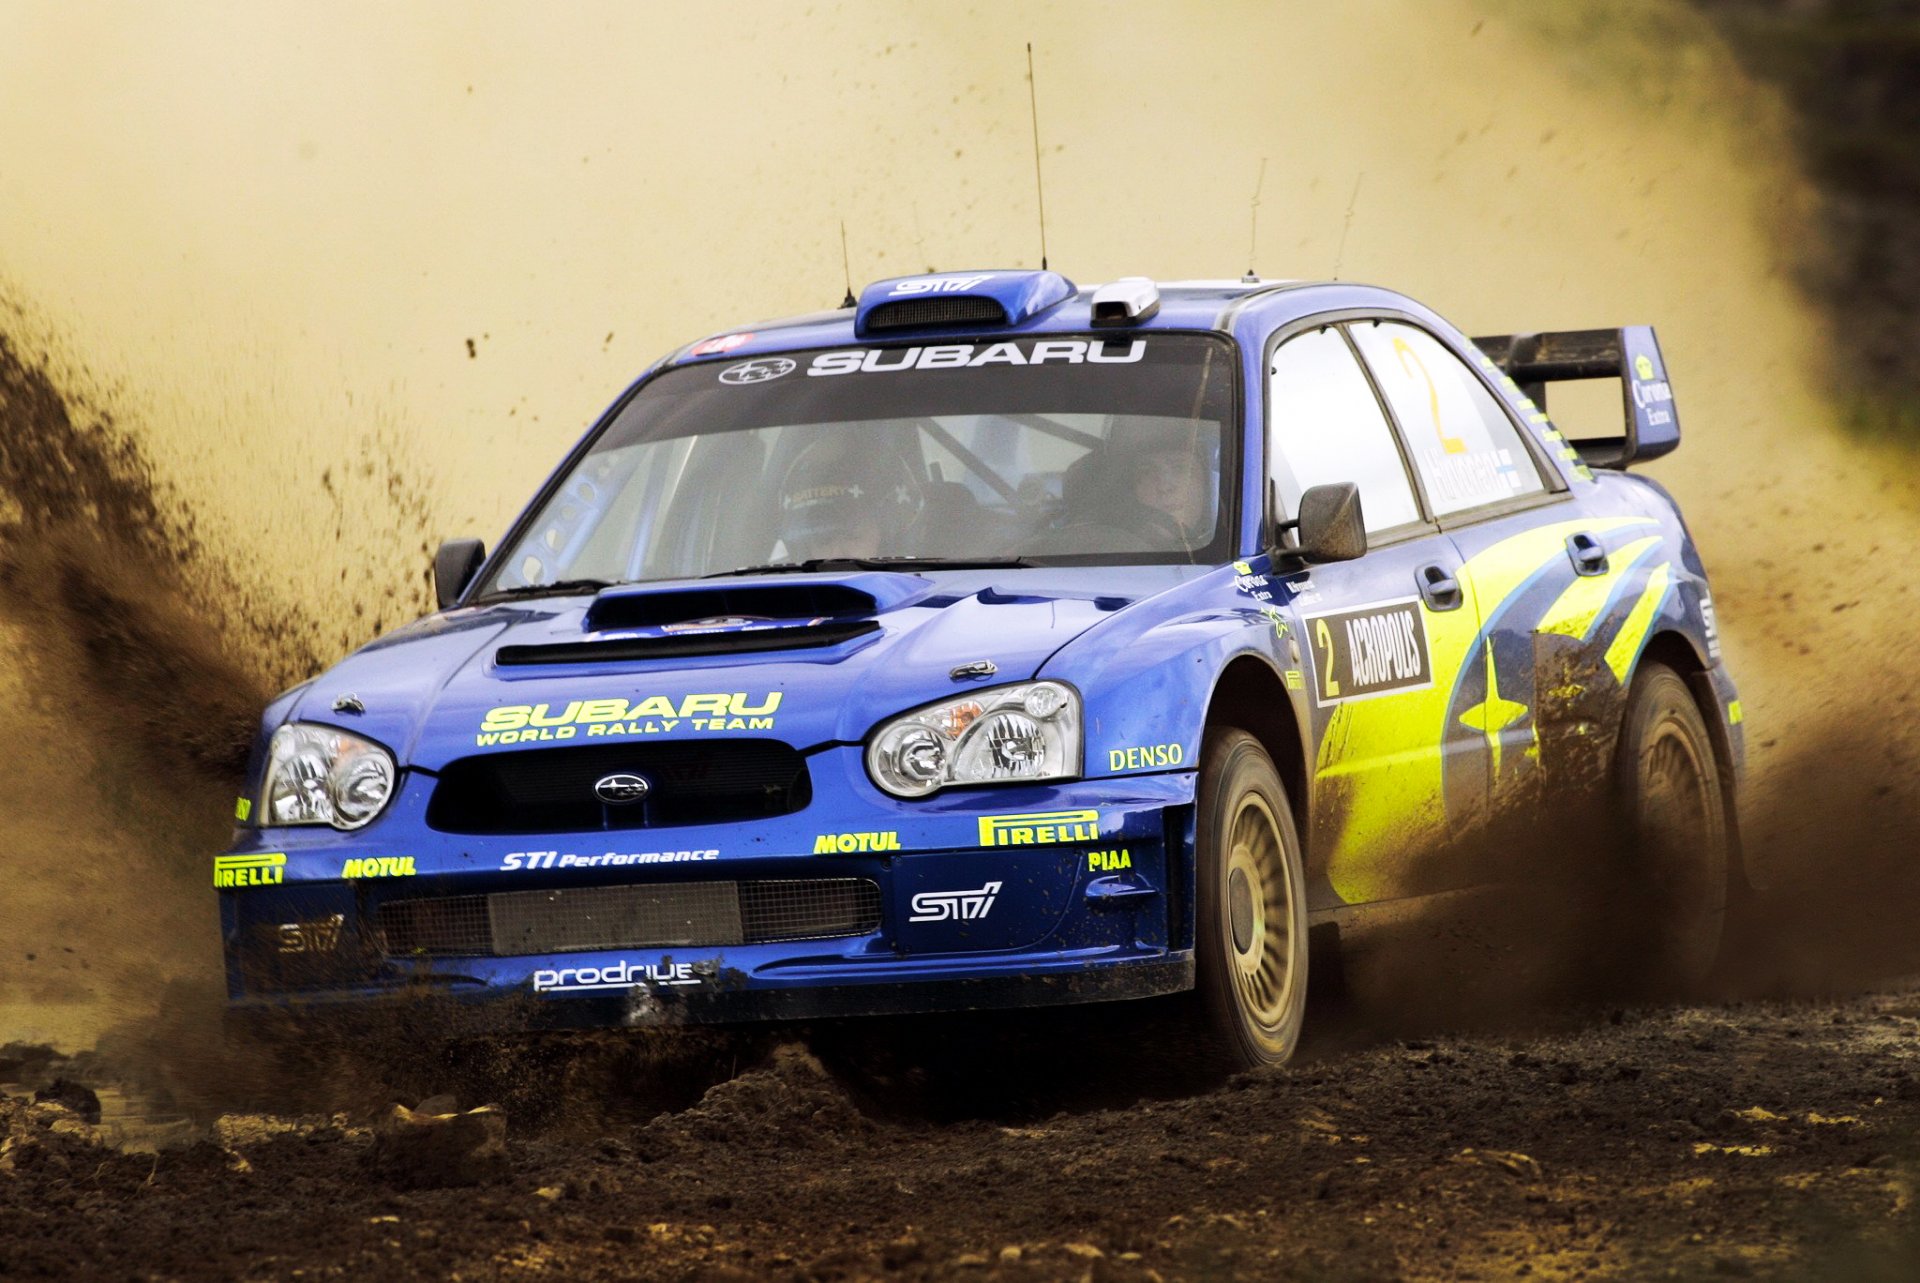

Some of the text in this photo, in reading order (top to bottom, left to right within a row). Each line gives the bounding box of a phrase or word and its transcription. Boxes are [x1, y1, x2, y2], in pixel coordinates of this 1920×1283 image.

[806, 340, 1147, 377] SUBARU
[1392, 337, 1467, 455] 2
[1316, 610, 1421, 697] 2 ACROPOLIS
[480, 691, 783, 732] SUBARU
[476, 717, 774, 747] WORLD RALLY TEAM
[1108, 743, 1183, 772] DENSO
[813, 831, 901, 854] MOTUL
[978, 809, 1099, 847] PIRELLI
[213, 852, 287, 888] PIRELLI
[341, 856, 417, 879] MOTUL
[499, 849, 720, 871] STI Performance
[1088, 849, 1132, 872] PIAA
